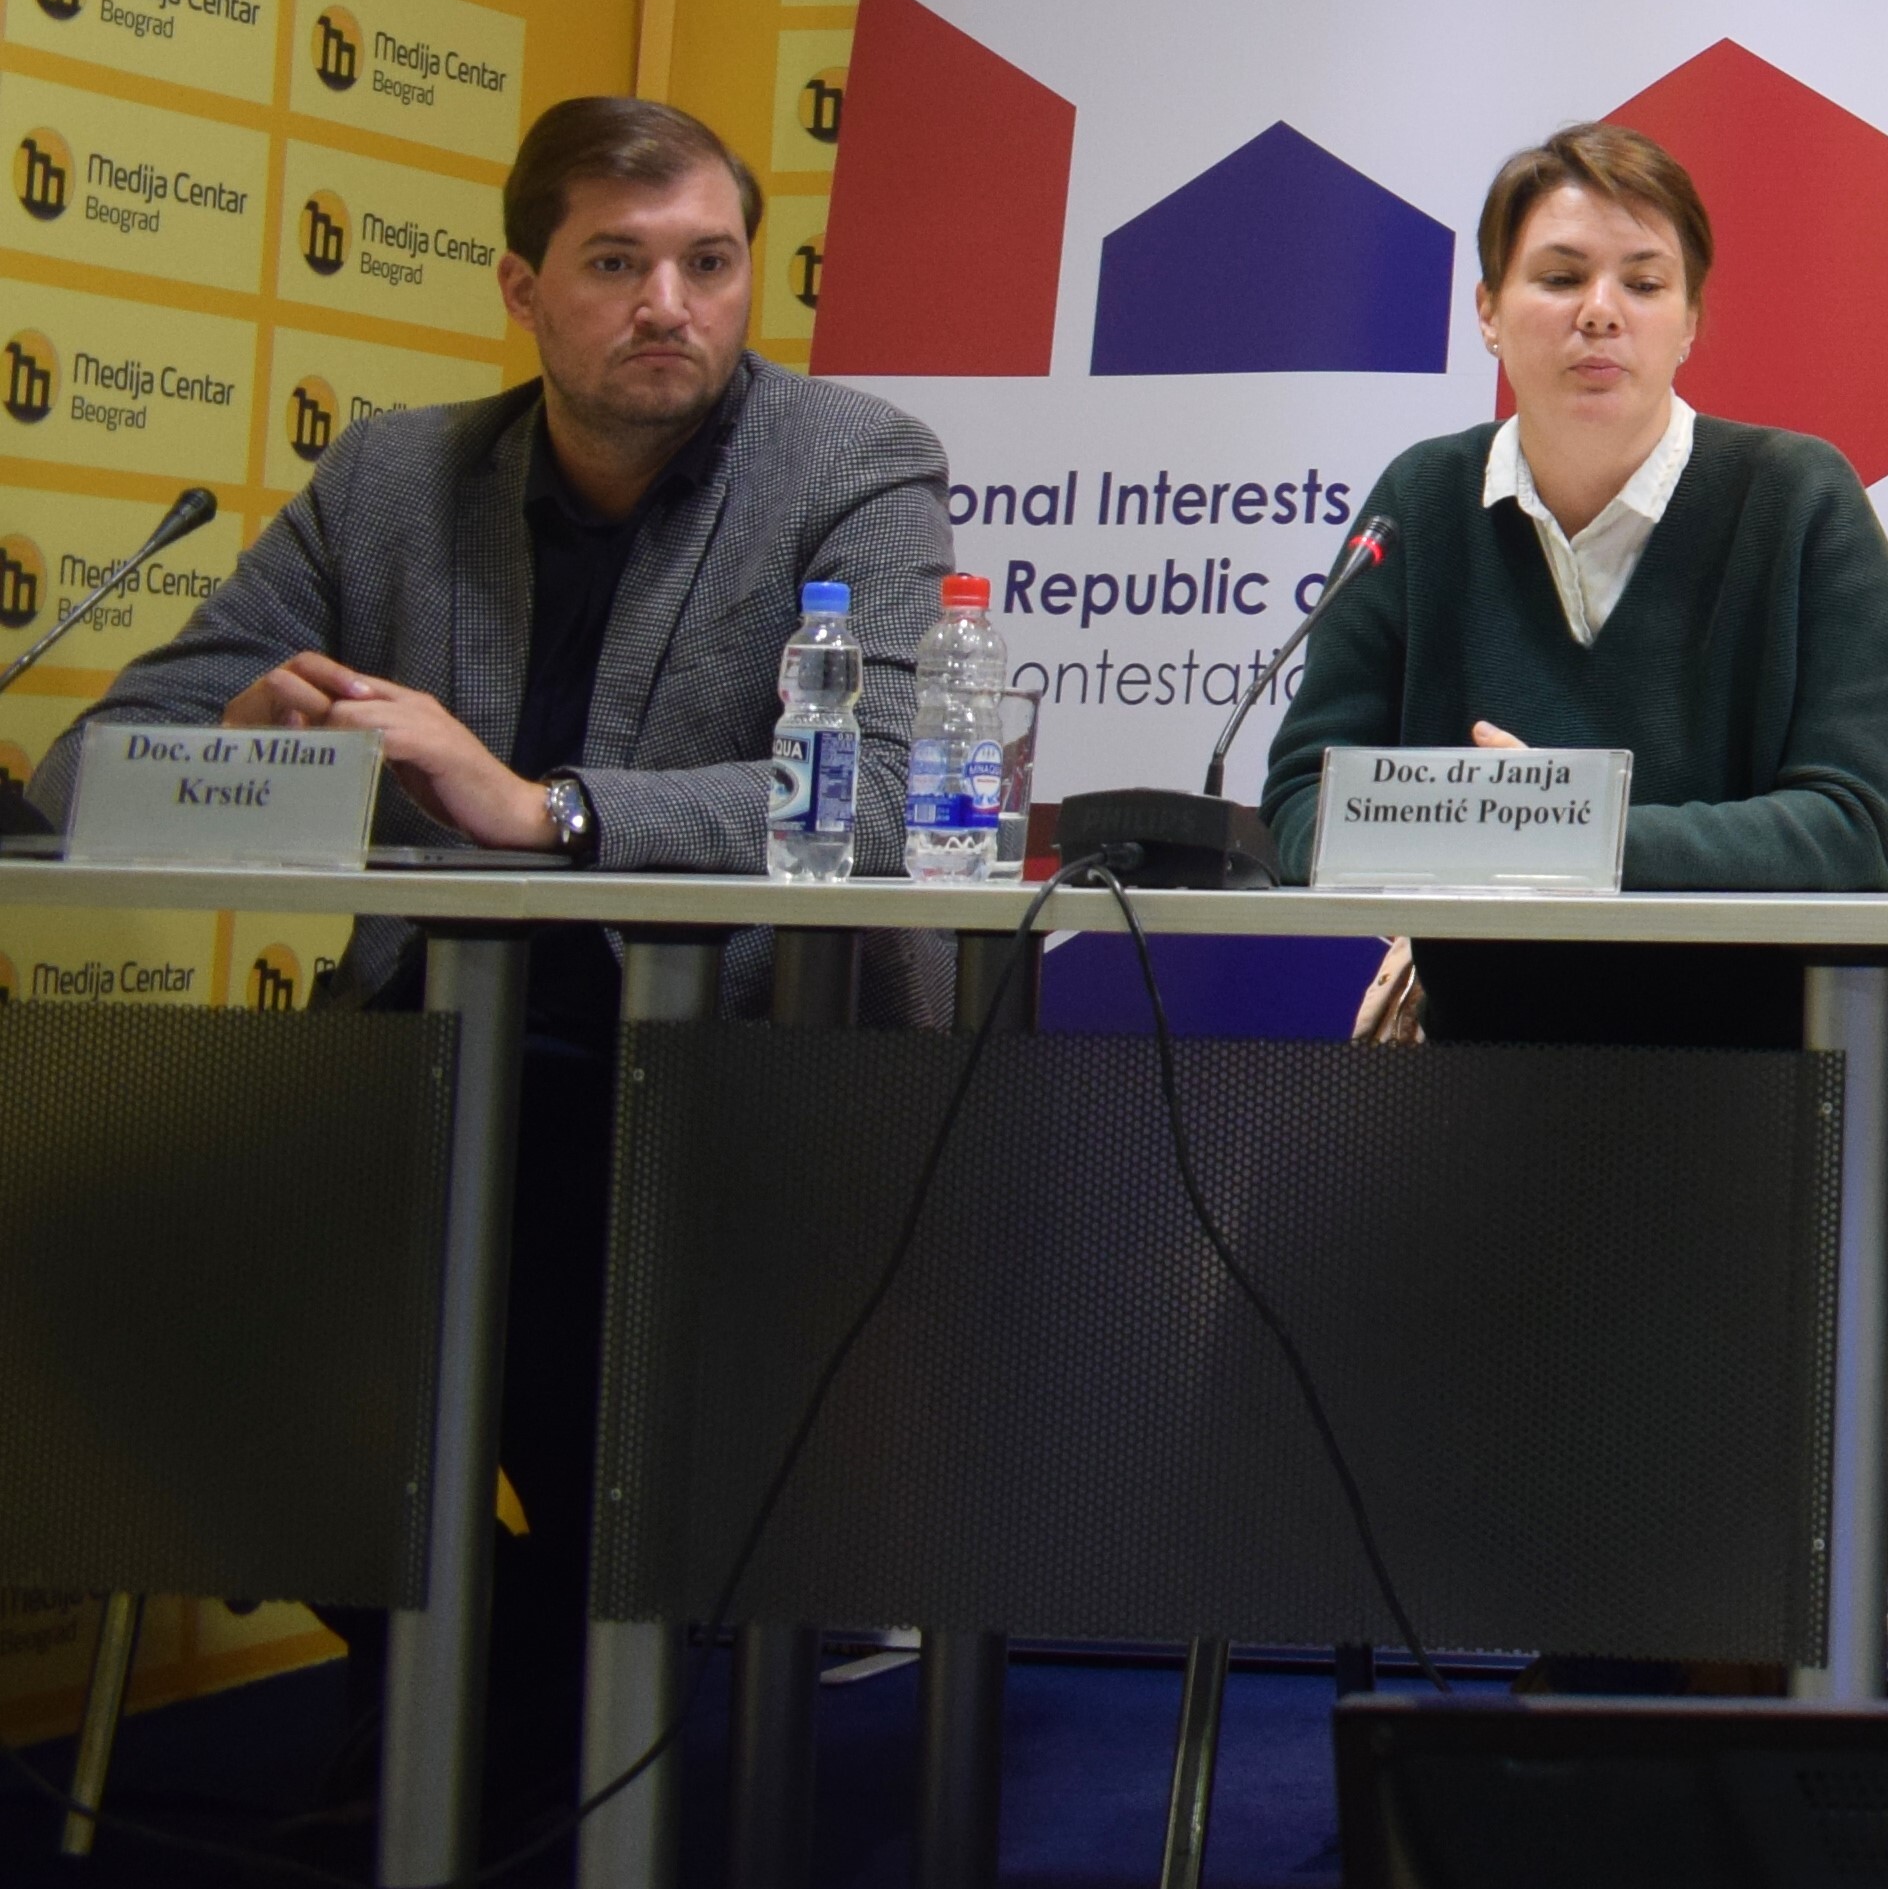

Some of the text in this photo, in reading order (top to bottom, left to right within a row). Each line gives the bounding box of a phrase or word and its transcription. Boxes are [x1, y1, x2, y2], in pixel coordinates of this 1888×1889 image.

[1098, 468, 1352, 529] Interests
[1003, 557, 1269, 629] Republic
[126, 734, 336, 766] Doc. dr Milan
[177, 777, 270, 807] Krstić
[1373, 758, 1571, 792] Doc. dr Janja
[1344, 797, 1591, 831] Simentić Popović
